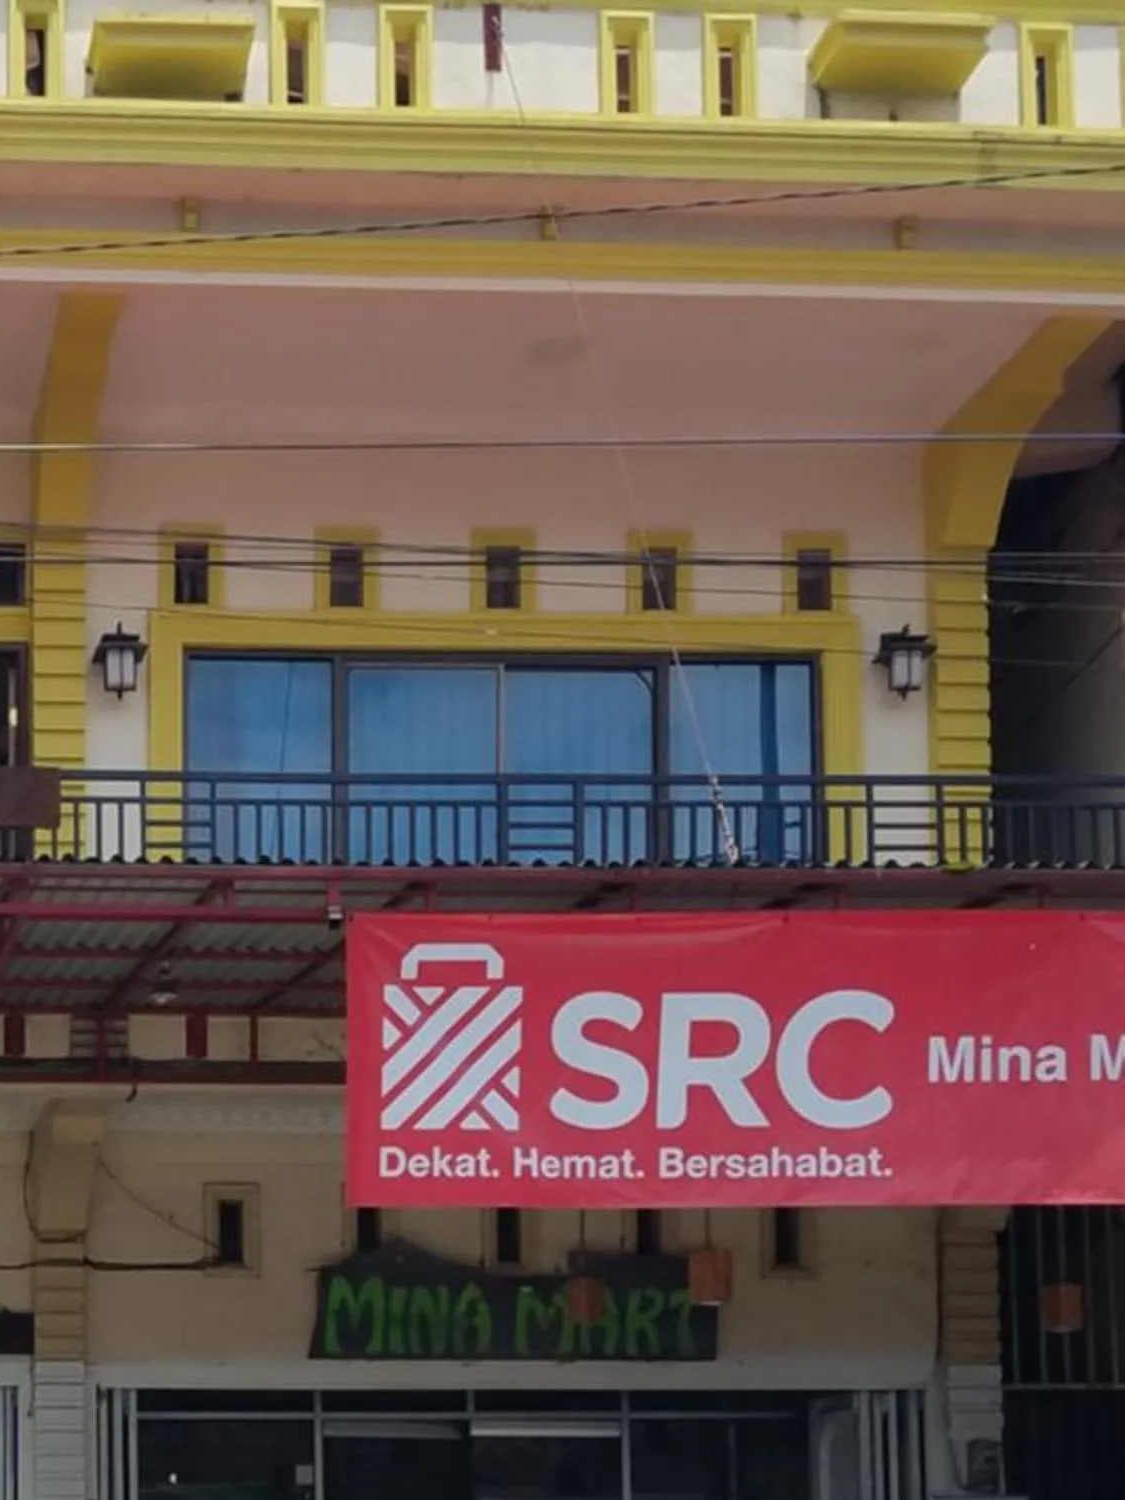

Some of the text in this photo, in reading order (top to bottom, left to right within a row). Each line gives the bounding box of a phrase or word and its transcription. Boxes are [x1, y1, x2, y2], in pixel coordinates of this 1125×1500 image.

[549, 989, 896, 1131] SRC
[927, 1036, 1068, 1083] Mina
[378, 1145, 894, 1180] Dekat. Hemat. Bersahabat.
[324, 1273, 494, 1354] MINA
